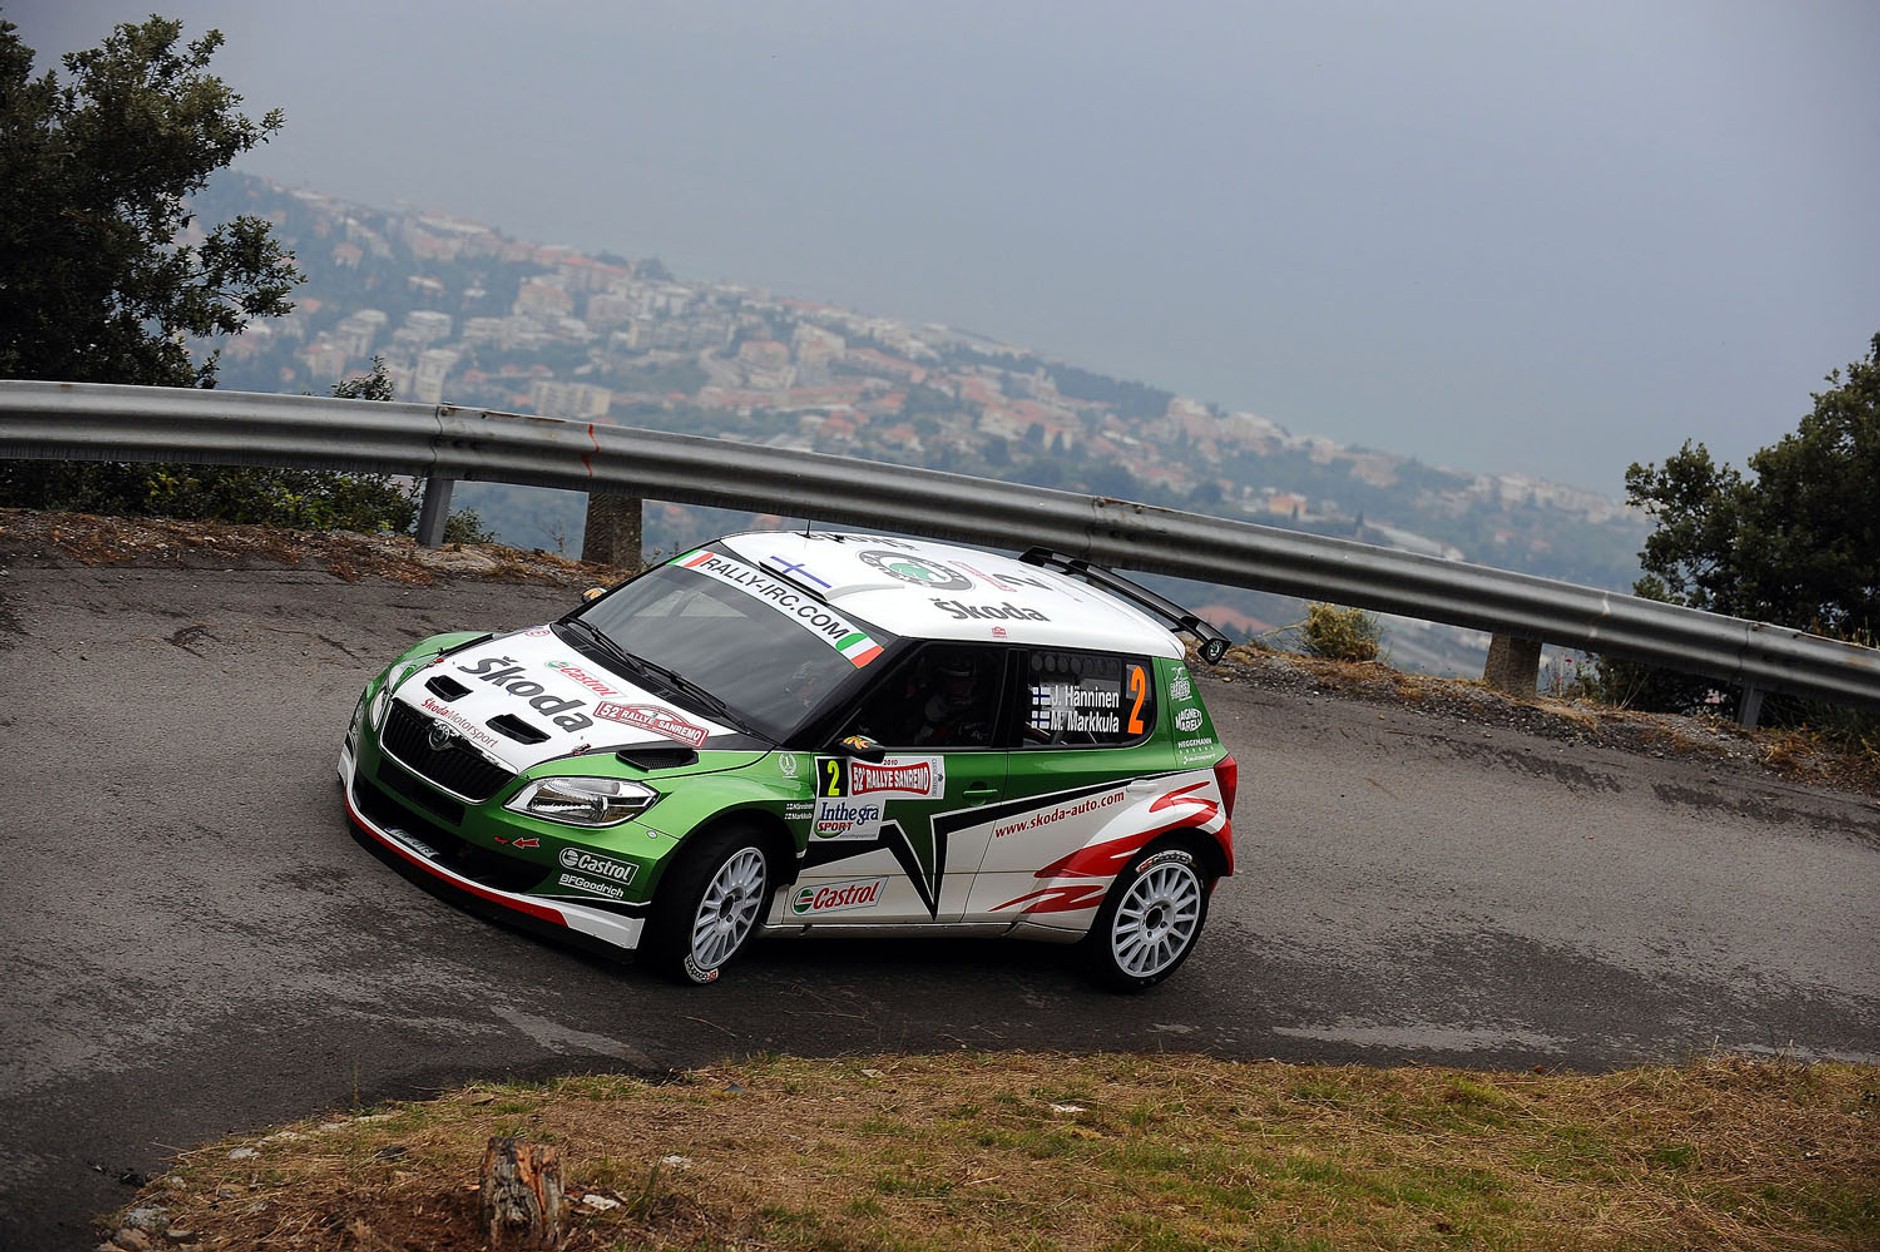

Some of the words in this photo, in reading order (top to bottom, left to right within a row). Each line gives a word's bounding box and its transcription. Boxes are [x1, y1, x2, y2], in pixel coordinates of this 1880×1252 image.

[700, 558, 850, 640] RALLY-IRC.COM
[929, 598, 1051, 622] Škoda
[457, 655, 594, 733] Škoda
[560, 666, 619, 697] Castrol
[1051, 685, 1062, 706] J.
[1065, 685, 1119, 708] Hänninen
[1127, 666, 1146, 734] 2
[658, 720, 702, 742] SANREMO
[1050, 711, 1063, 731] M.
[1067, 711, 1119, 733] Markkula
[827, 760, 840, 796] 2
[866, 768, 893, 790] RALLYE
[894, 766, 929, 791] SANREMO
[817, 822, 853, 832] SPORT
[995, 791, 1125, 838] www.skoda-auto.com
[577, 854, 632, 881] Castrol
[560, 873, 624, 898] BFGoodrich
[813, 881, 880, 910] Castrol
